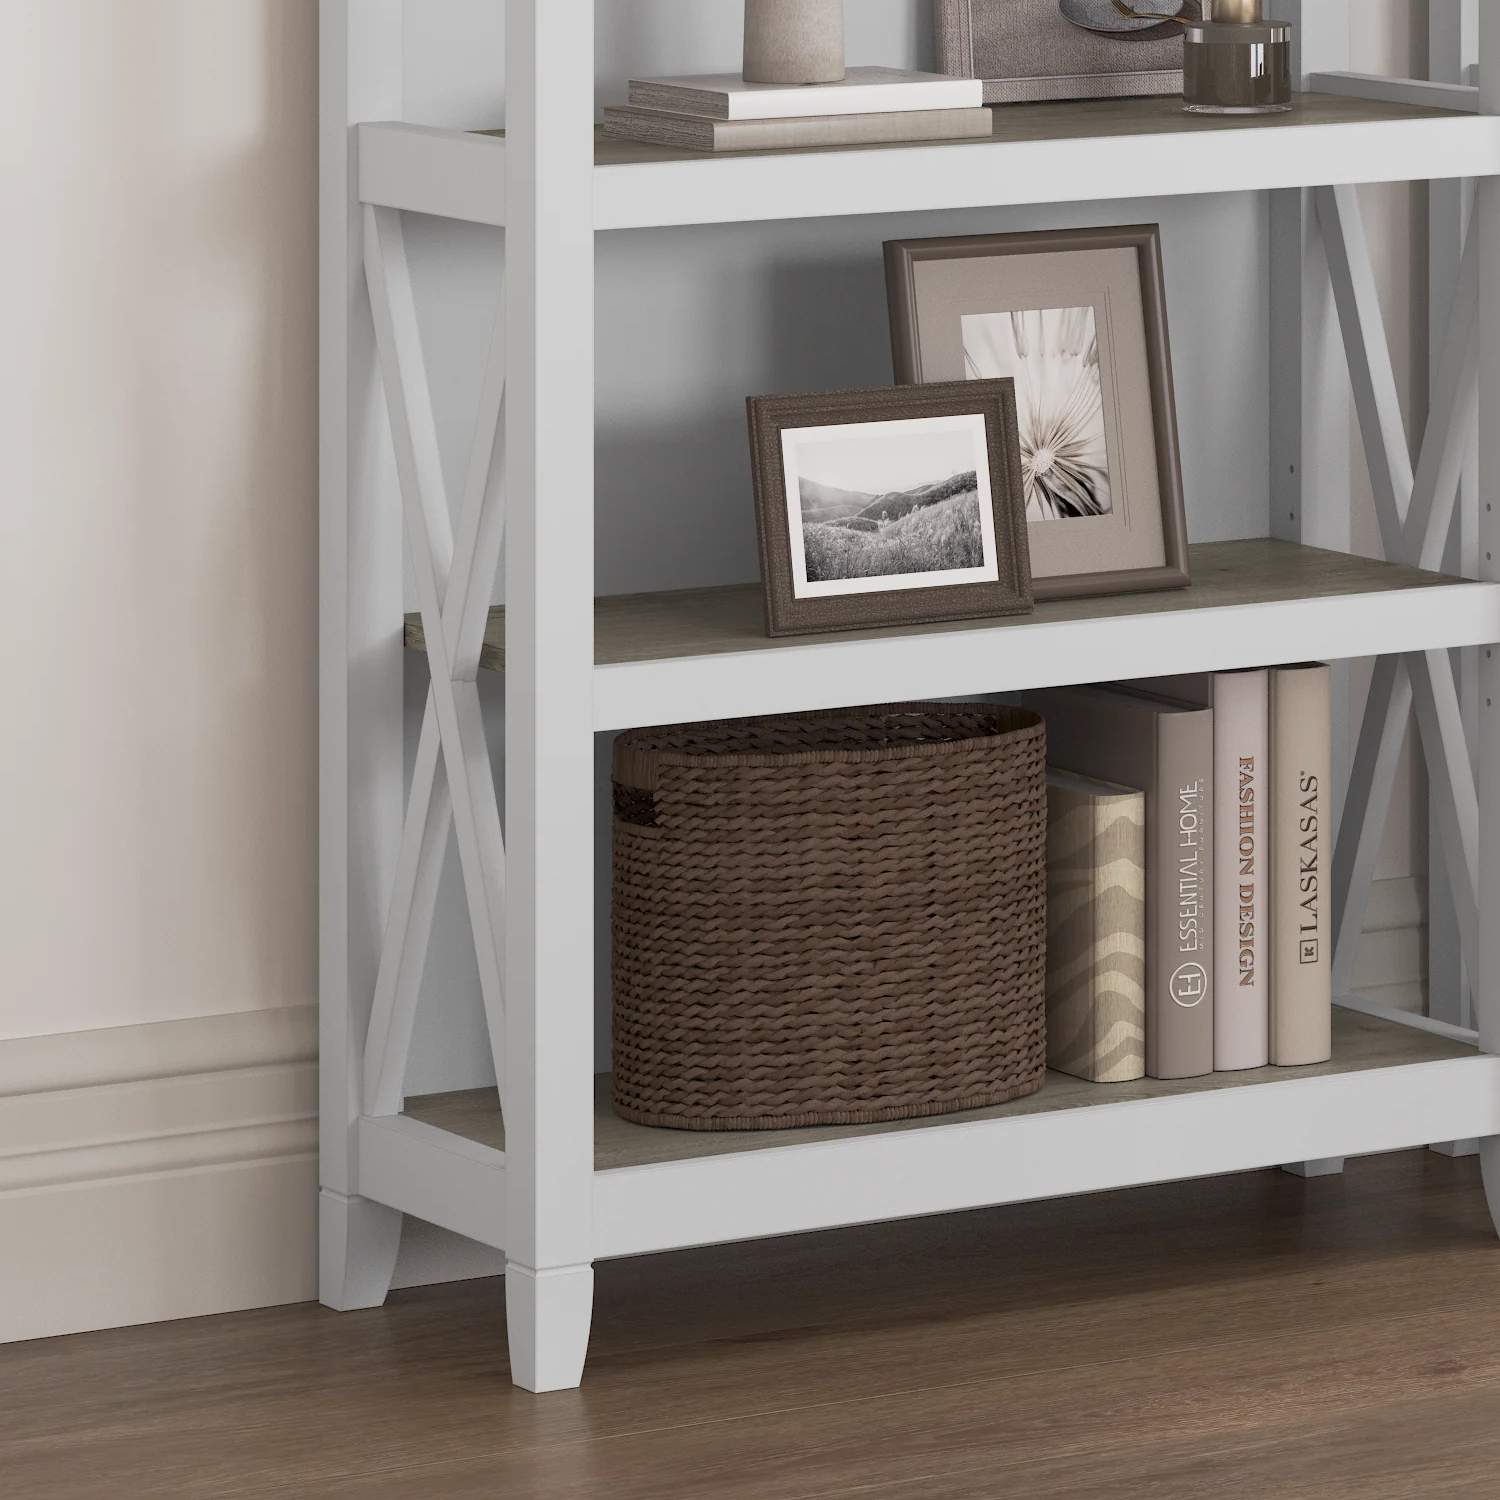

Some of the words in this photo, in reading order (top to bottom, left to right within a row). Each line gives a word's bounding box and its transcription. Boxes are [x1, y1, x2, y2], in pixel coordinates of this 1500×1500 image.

[1179, 780, 1198, 848] HOME
[1239, 755, 1255, 876] FASHION
[1300, 774, 1318, 934] LASKASAS
[1179, 850, 1198, 953] ESSENTIAL
[1239, 882, 1255, 987] DESIGN
